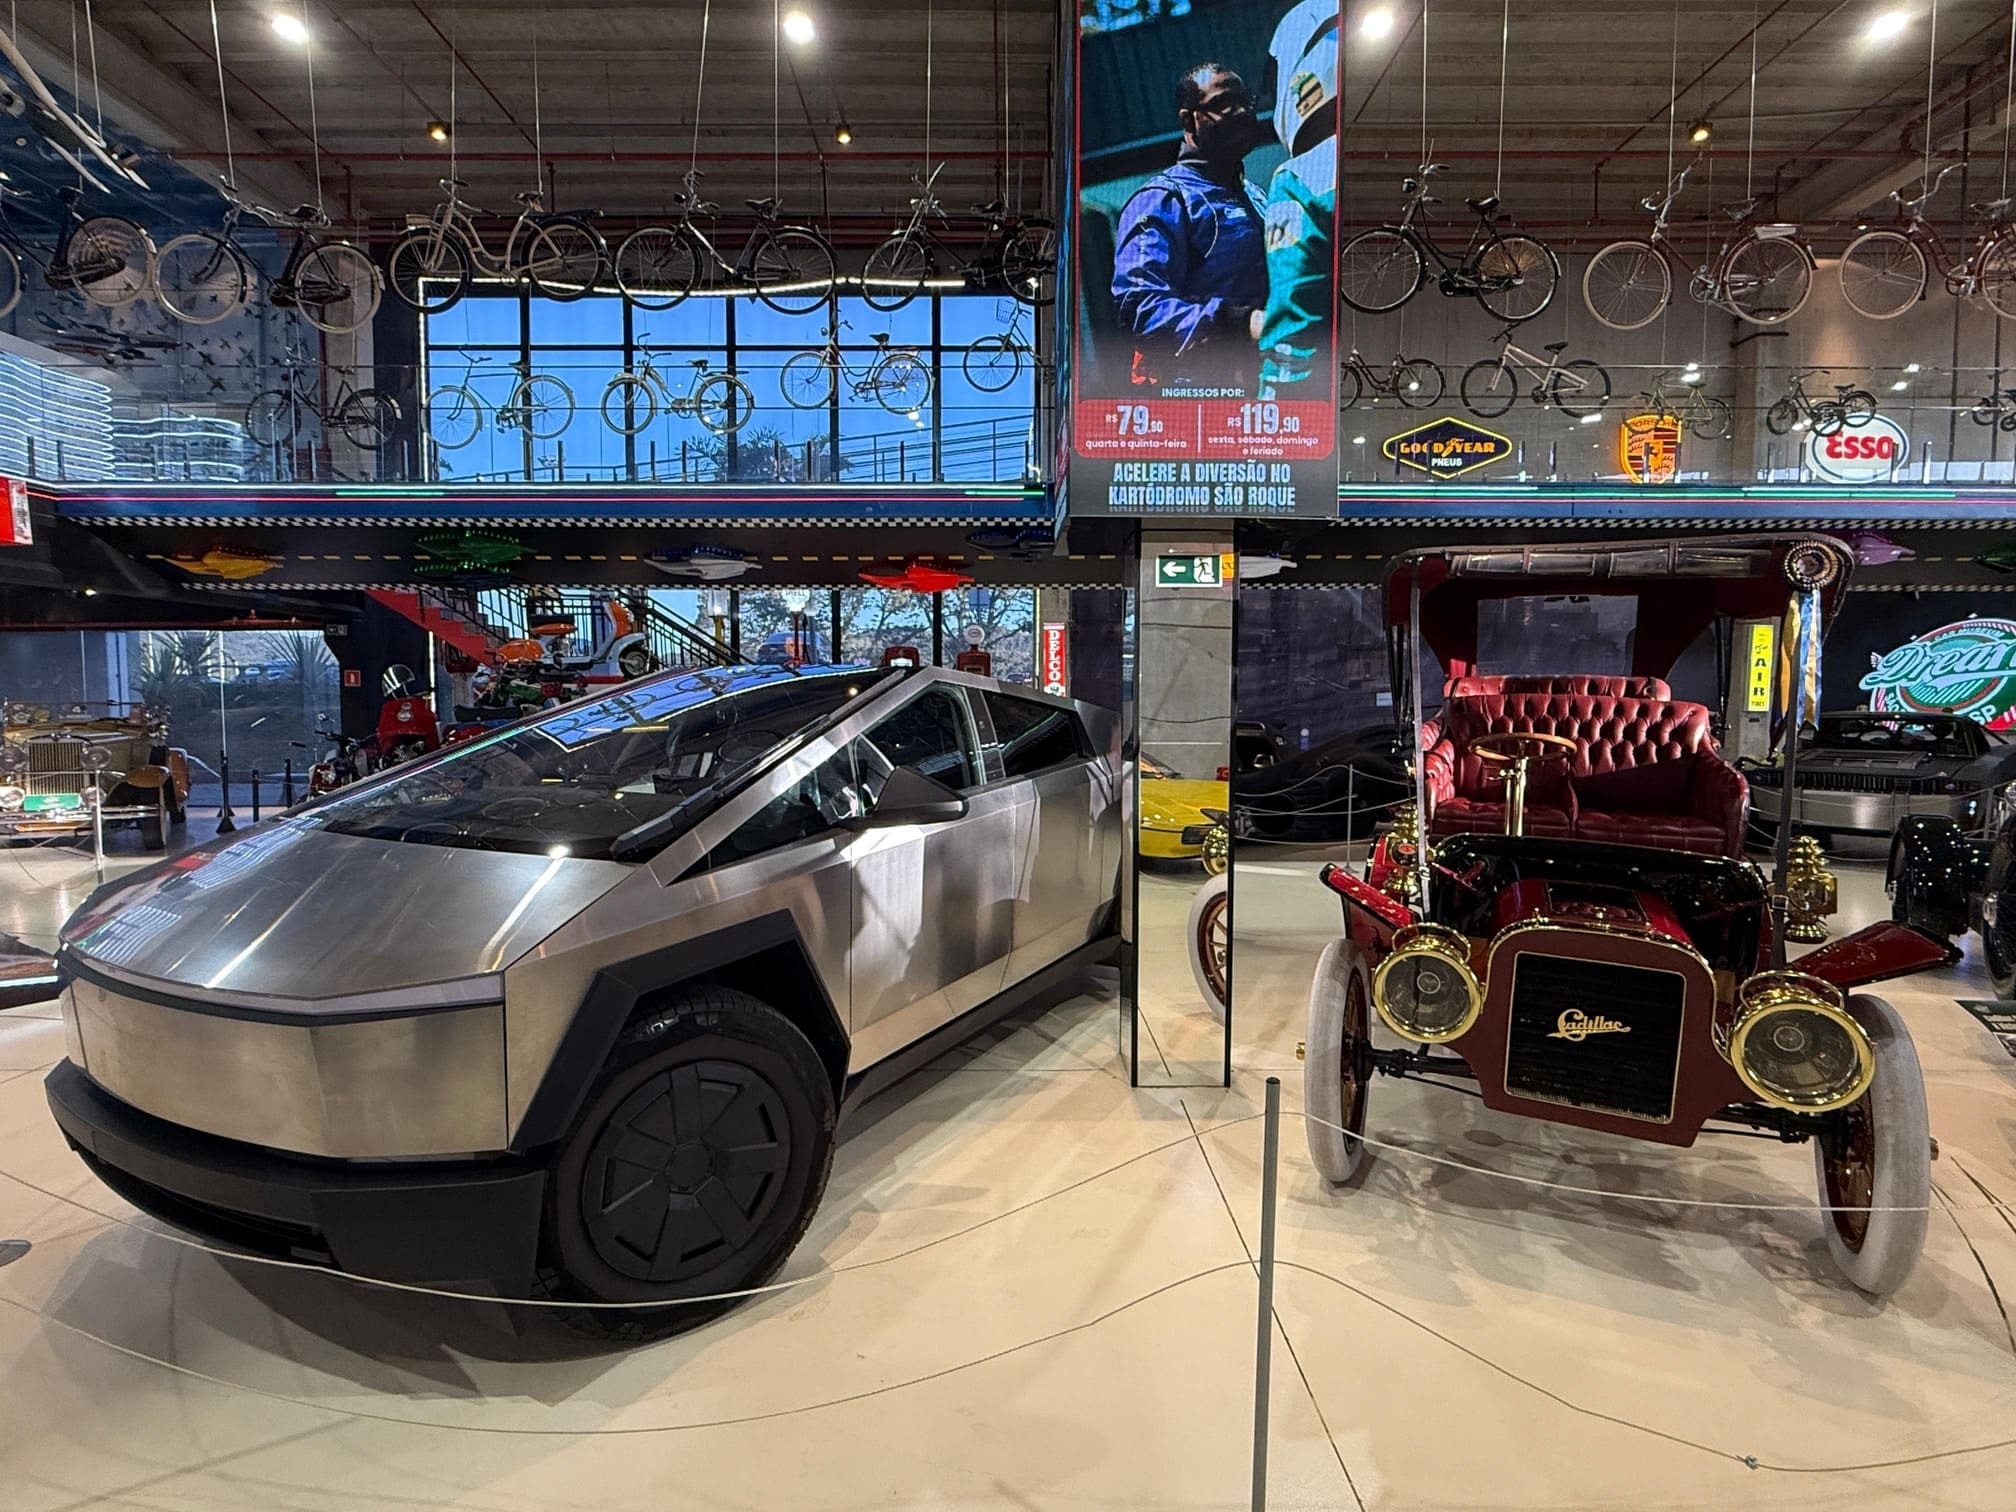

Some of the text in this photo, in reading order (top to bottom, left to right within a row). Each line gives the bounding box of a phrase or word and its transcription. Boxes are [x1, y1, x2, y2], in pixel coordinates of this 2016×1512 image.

[1161, 388, 1245, 398] INGRESSOS POR:
[1085, 440, 1118, 450] quarta
[1128, 439, 1187, 450] quinta-feira
[1276, 435, 1319, 446] domingo
[1250, 446, 1284, 456] feriado
[1431, 457, 1463, 467] PNEUS
[1113, 459, 1291, 483] ACELERE A DIVERSÃO NO
[1108, 482, 1296, 507] KARTÓDROMO SÃO ROQUE
[1048, 629, 1062, 682] DELCO
[1753, 657, 1767, 697] AIR
[1546, 1008, 1632, 1042] Cadillac
